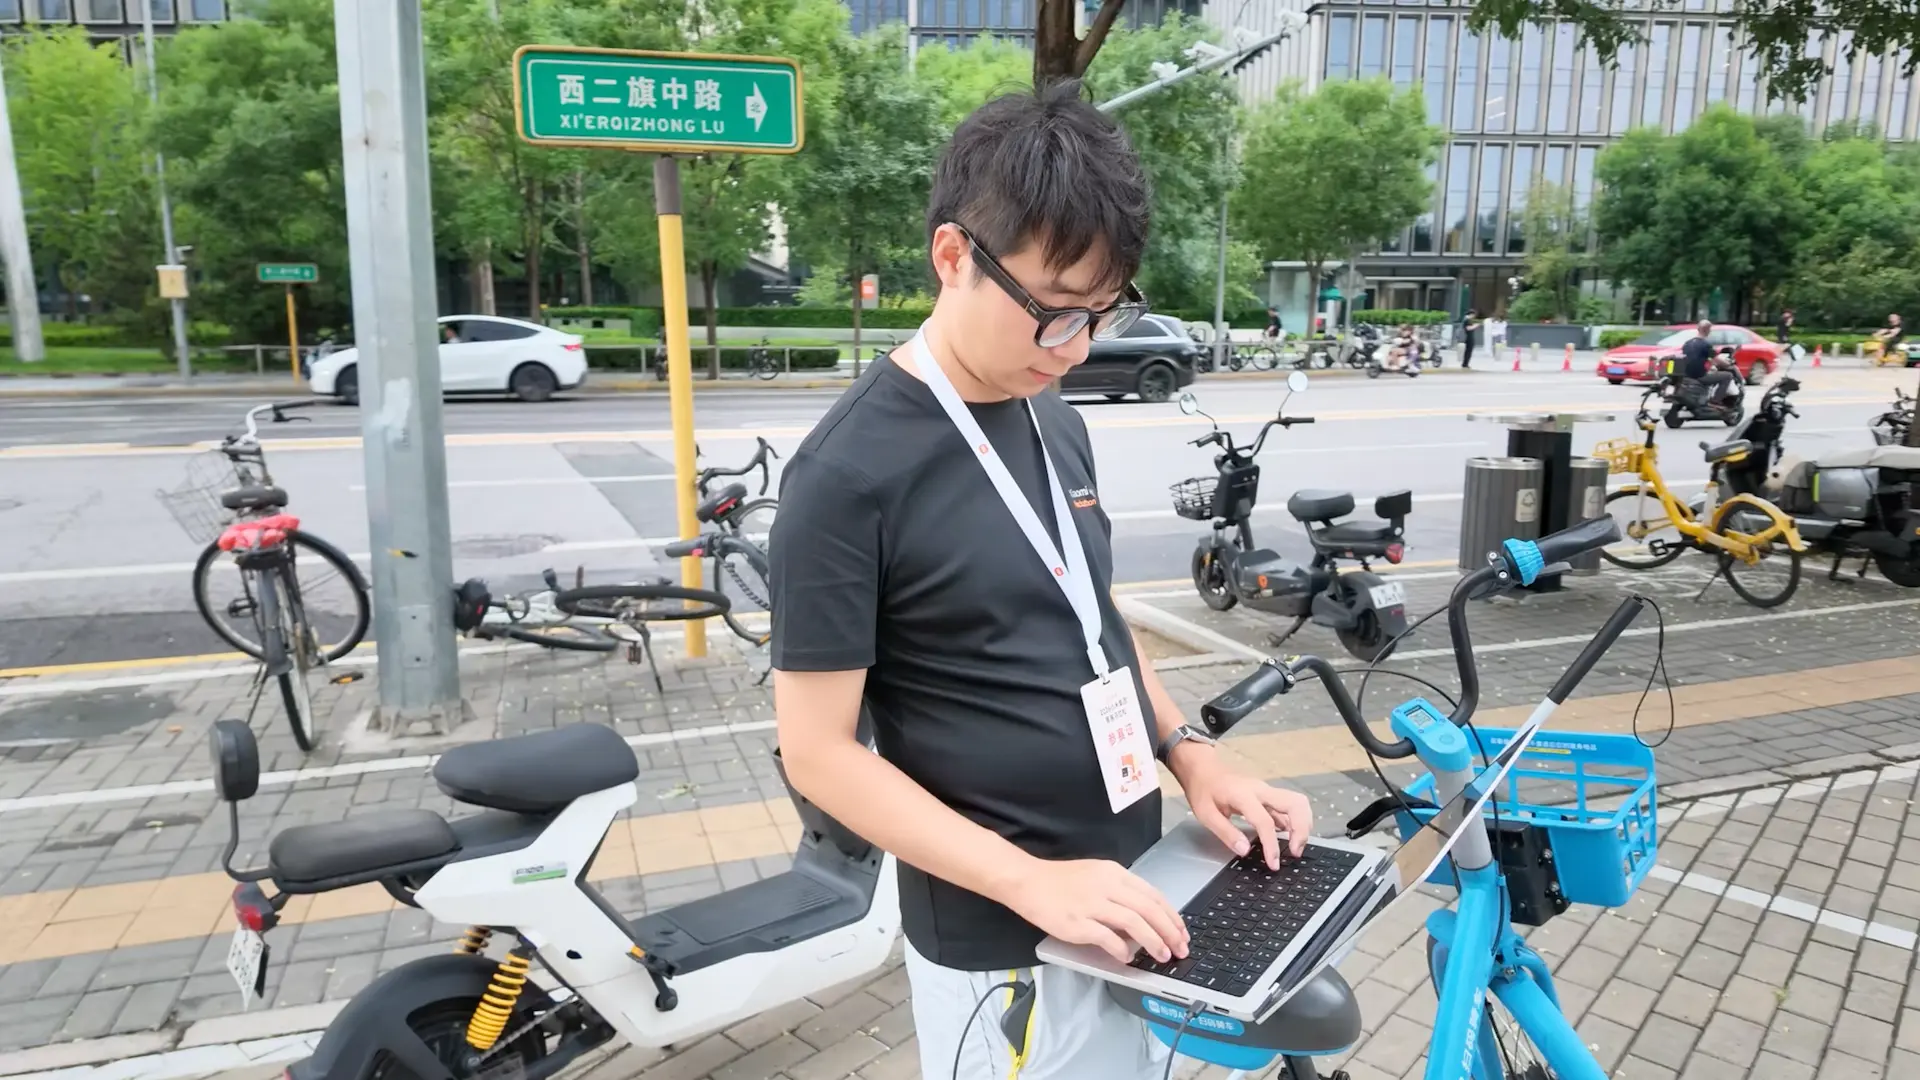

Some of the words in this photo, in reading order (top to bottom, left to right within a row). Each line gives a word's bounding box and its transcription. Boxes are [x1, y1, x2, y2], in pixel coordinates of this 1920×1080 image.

[556, 73, 722, 112] 西二旗中路
[559, 113, 696, 133] XI'ERQIZHONG
[701, 119, 725, 134] LU
